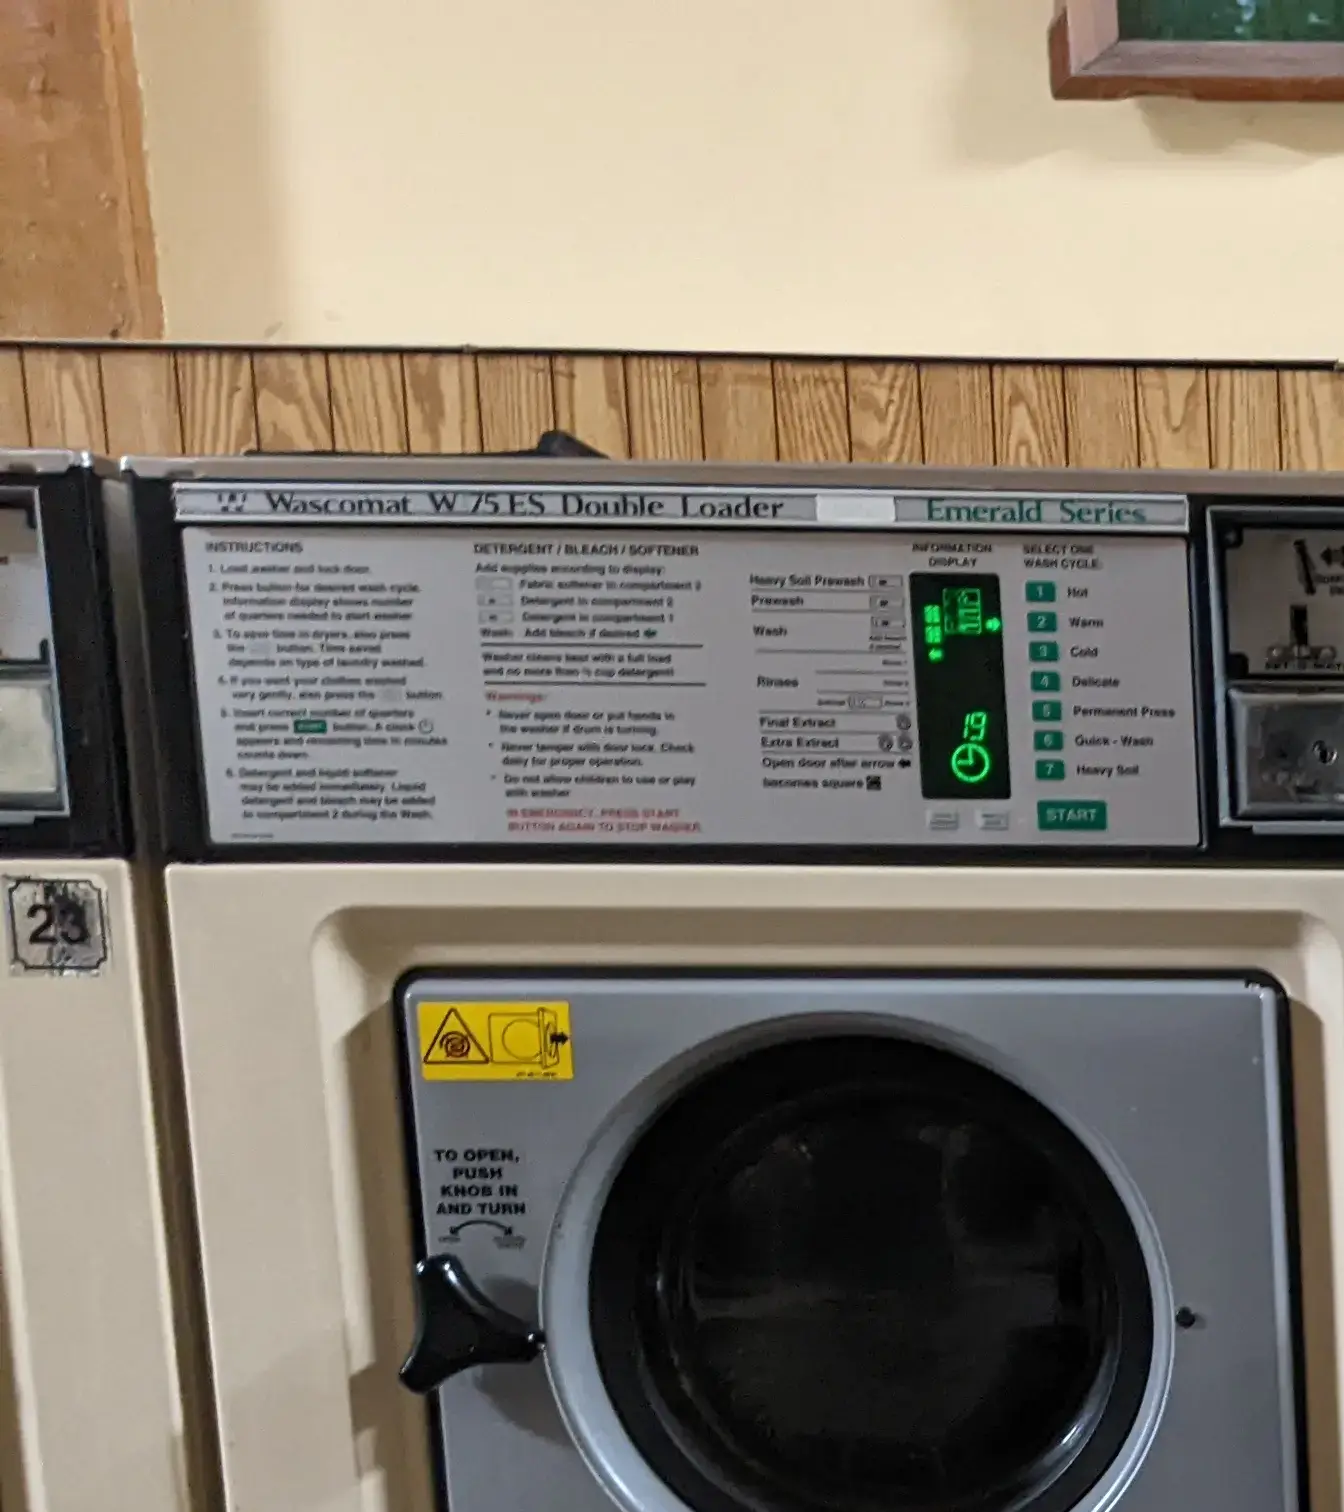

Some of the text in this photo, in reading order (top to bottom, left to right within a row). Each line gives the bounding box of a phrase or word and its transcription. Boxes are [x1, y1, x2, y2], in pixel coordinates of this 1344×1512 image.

[264, 491, 412, 514] Wascomat
[562, 494, 665, 517] Double
[680, 496, 783, 520] Loader
[926, 499, 1146, 525] Emerald Series
[205, 541, 303, 553] INSTRUCTIONS
[474, 543, 553, 555] DETERGENT
[564, 544, 619, 556] BLEACH
[629, 545, 699, 556] SOFTENER
[912, 544, 992, 554] INFORMATION
[1024, 544, 1094, 555] SELECT ONE
[929, 557, 977, 567] DISPLAY
[1024, 558, 1059, 568] WASH
[1036, 586, 1088, 599] 1 Hot
[1037, 616, 1103, 628] 2 Warm
[1039, 646, 1098, 658] 3 Cold
[1040, 676, 1120, 688] 4 Delicate
[1073, 706, 1137, 717] Permanent
[1142, 707, 1175, 718] Press
[1075, 735, 1109, 747] Quick
[1121, 736, 1153, 747] Wash
[1045, 764, 1139, 777] 7 Heavy Soil
[1046, 808, 1096, 822] START
[434, 1149, 520, 1164] TO OPEN,
[453, 1167, 503, 1180] PUSH
[441, 1184, 518, 1198] KNOB IN
[436, 1202, 526, 1215] AND TURN
